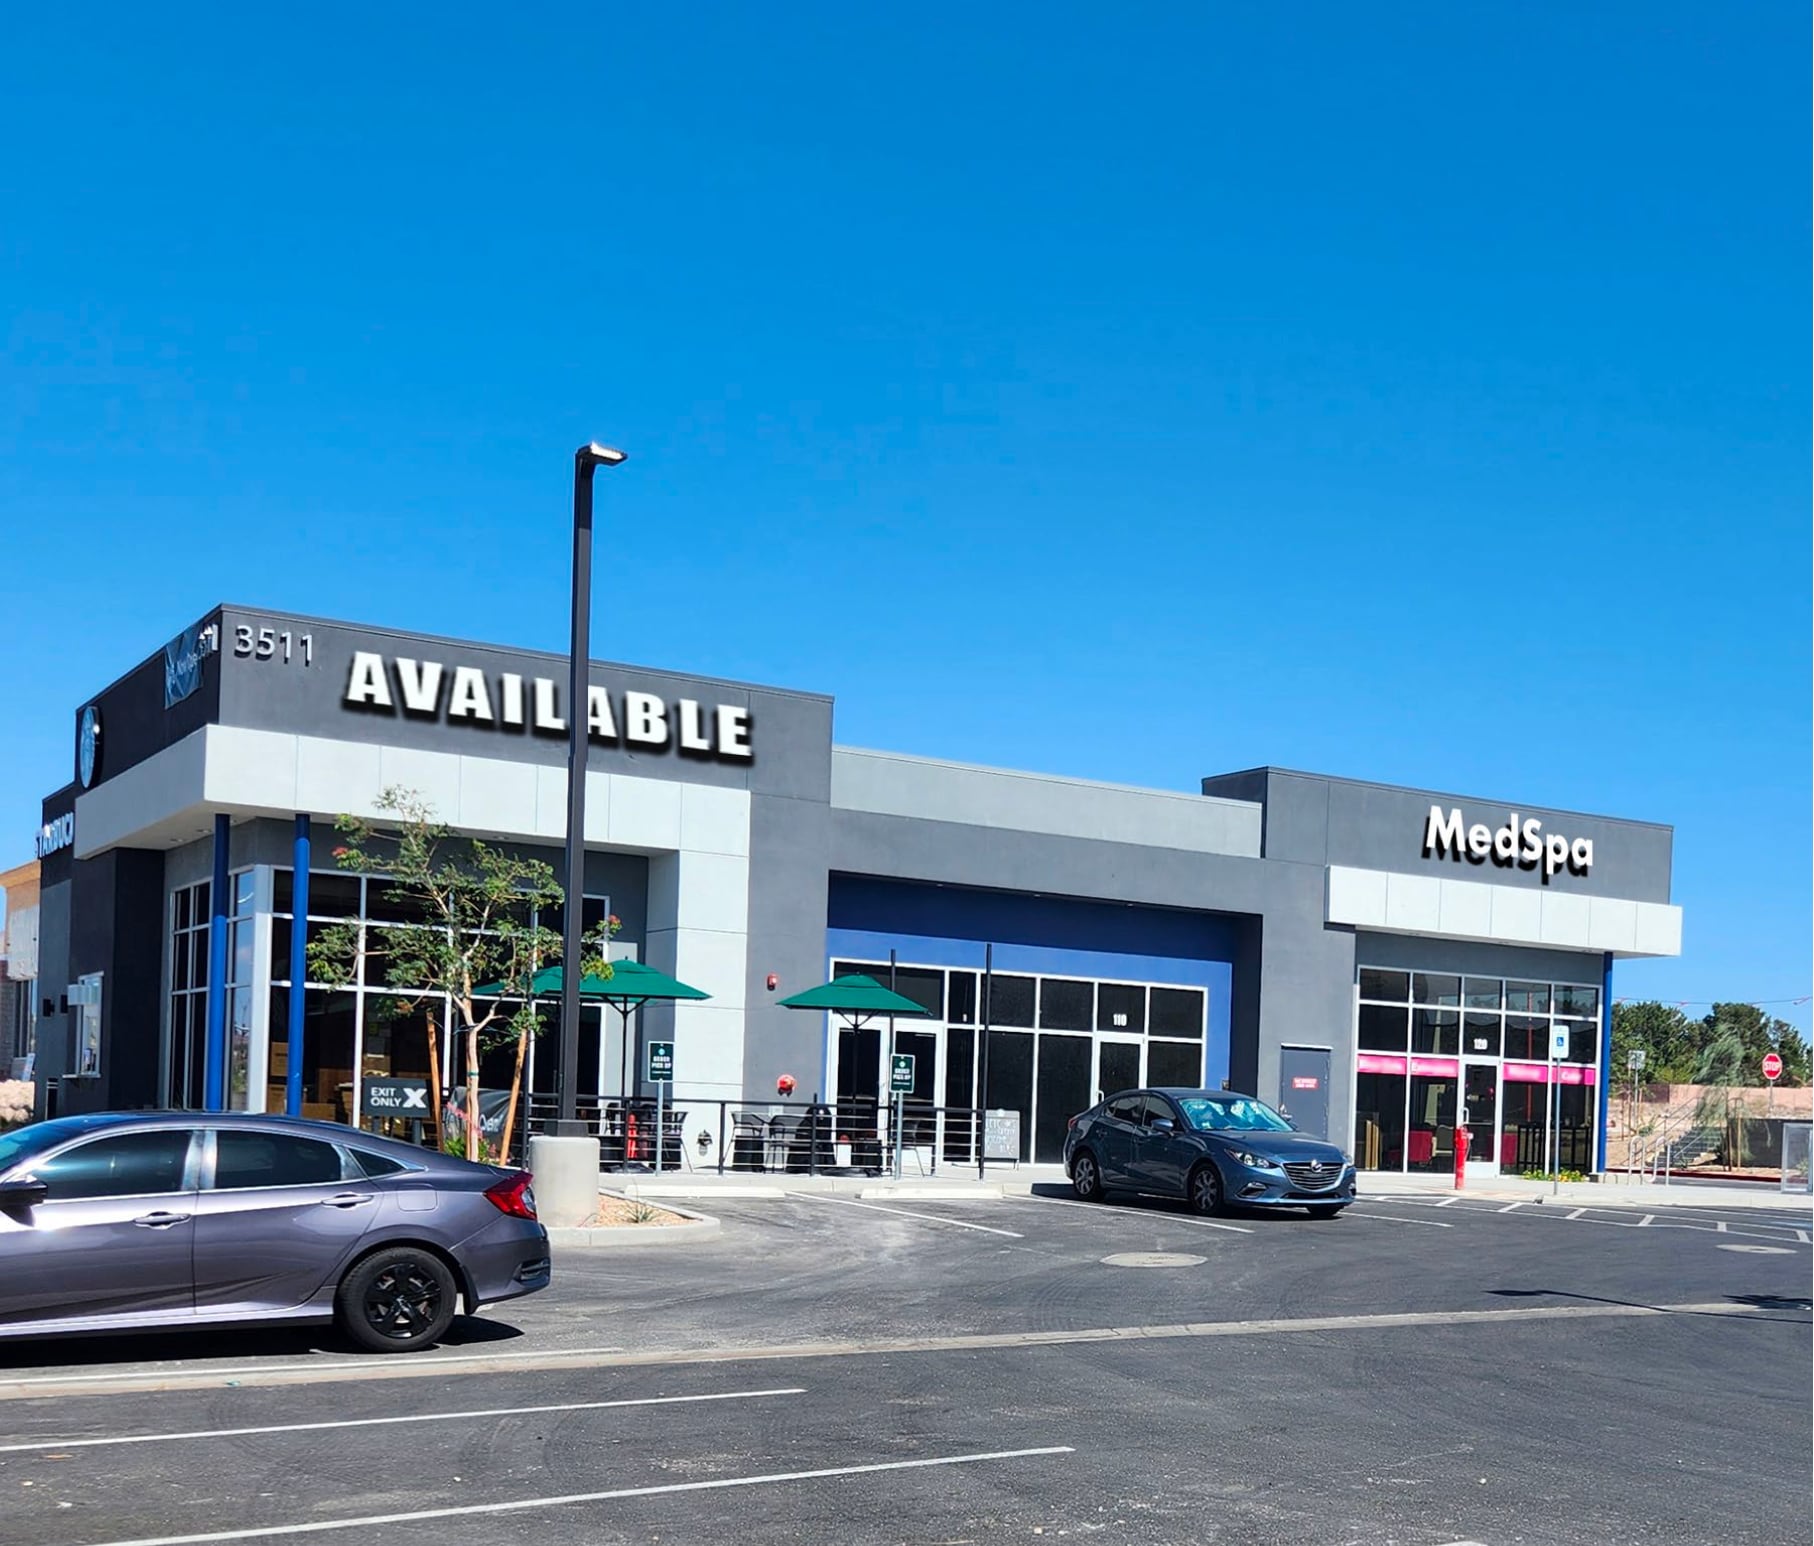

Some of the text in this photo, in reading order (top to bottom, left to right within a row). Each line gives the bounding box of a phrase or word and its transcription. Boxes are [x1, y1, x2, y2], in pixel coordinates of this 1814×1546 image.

[234, 624, 313, 663] 3511
[346, 650, 753, 758] AVAILABLE
[1425, 804, 1594, 876] MedSpa
[1113, 1013, 1127, 1026] 110
[1762, 1061, 1781, 1071] STOP
[370, 1086, 397, 1097] EXIT
[370, 1097, 402, 1107] ONLY
